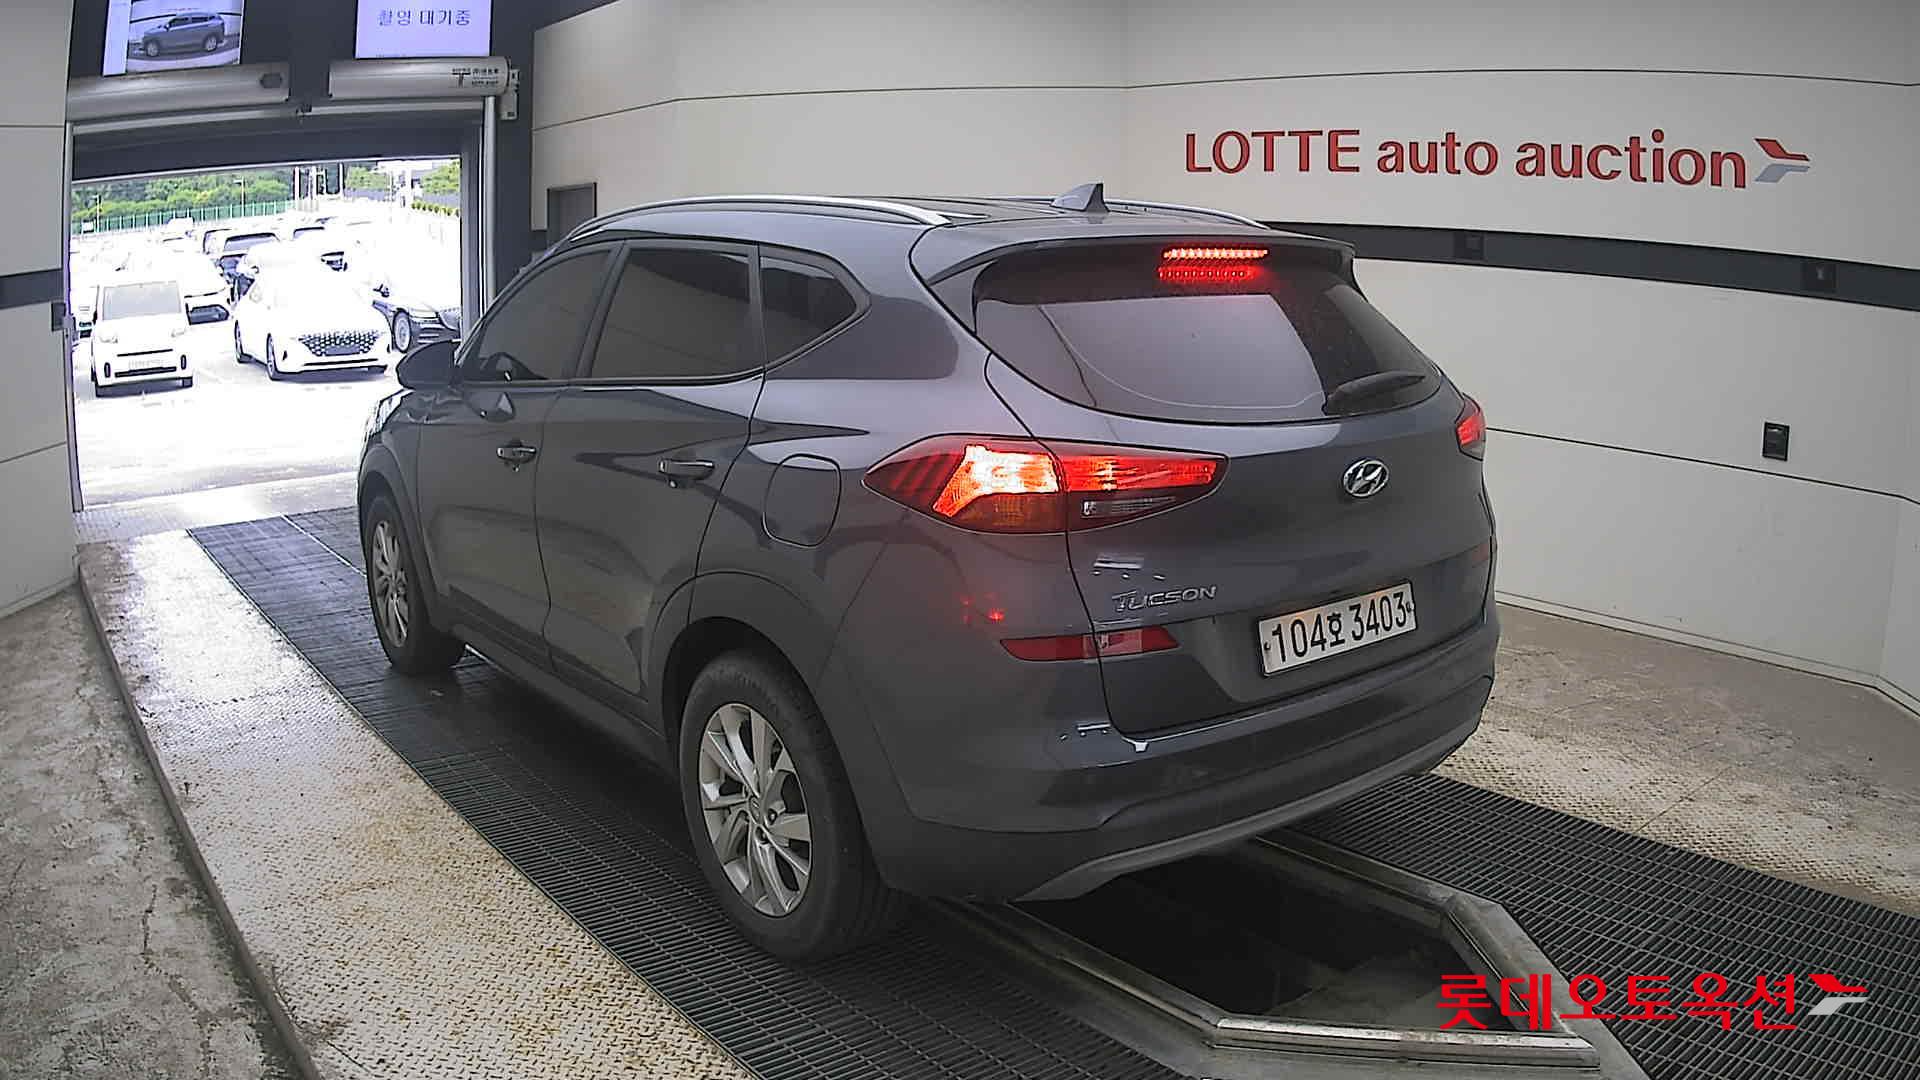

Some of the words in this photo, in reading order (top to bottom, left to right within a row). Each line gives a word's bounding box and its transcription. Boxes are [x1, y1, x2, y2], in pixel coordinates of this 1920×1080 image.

[419, 8, 471, 26] 대기중
[1185, 129, 1360, 174] LOTTE
[1376, 131, 1499, 176] auto
[1515, 128, 1747, 188] auction
[1111, 586, 1217, 612] TUCSON
[1271, 611, 1345, 663] 104호
[1349, 591, 1408, 642] 3403
